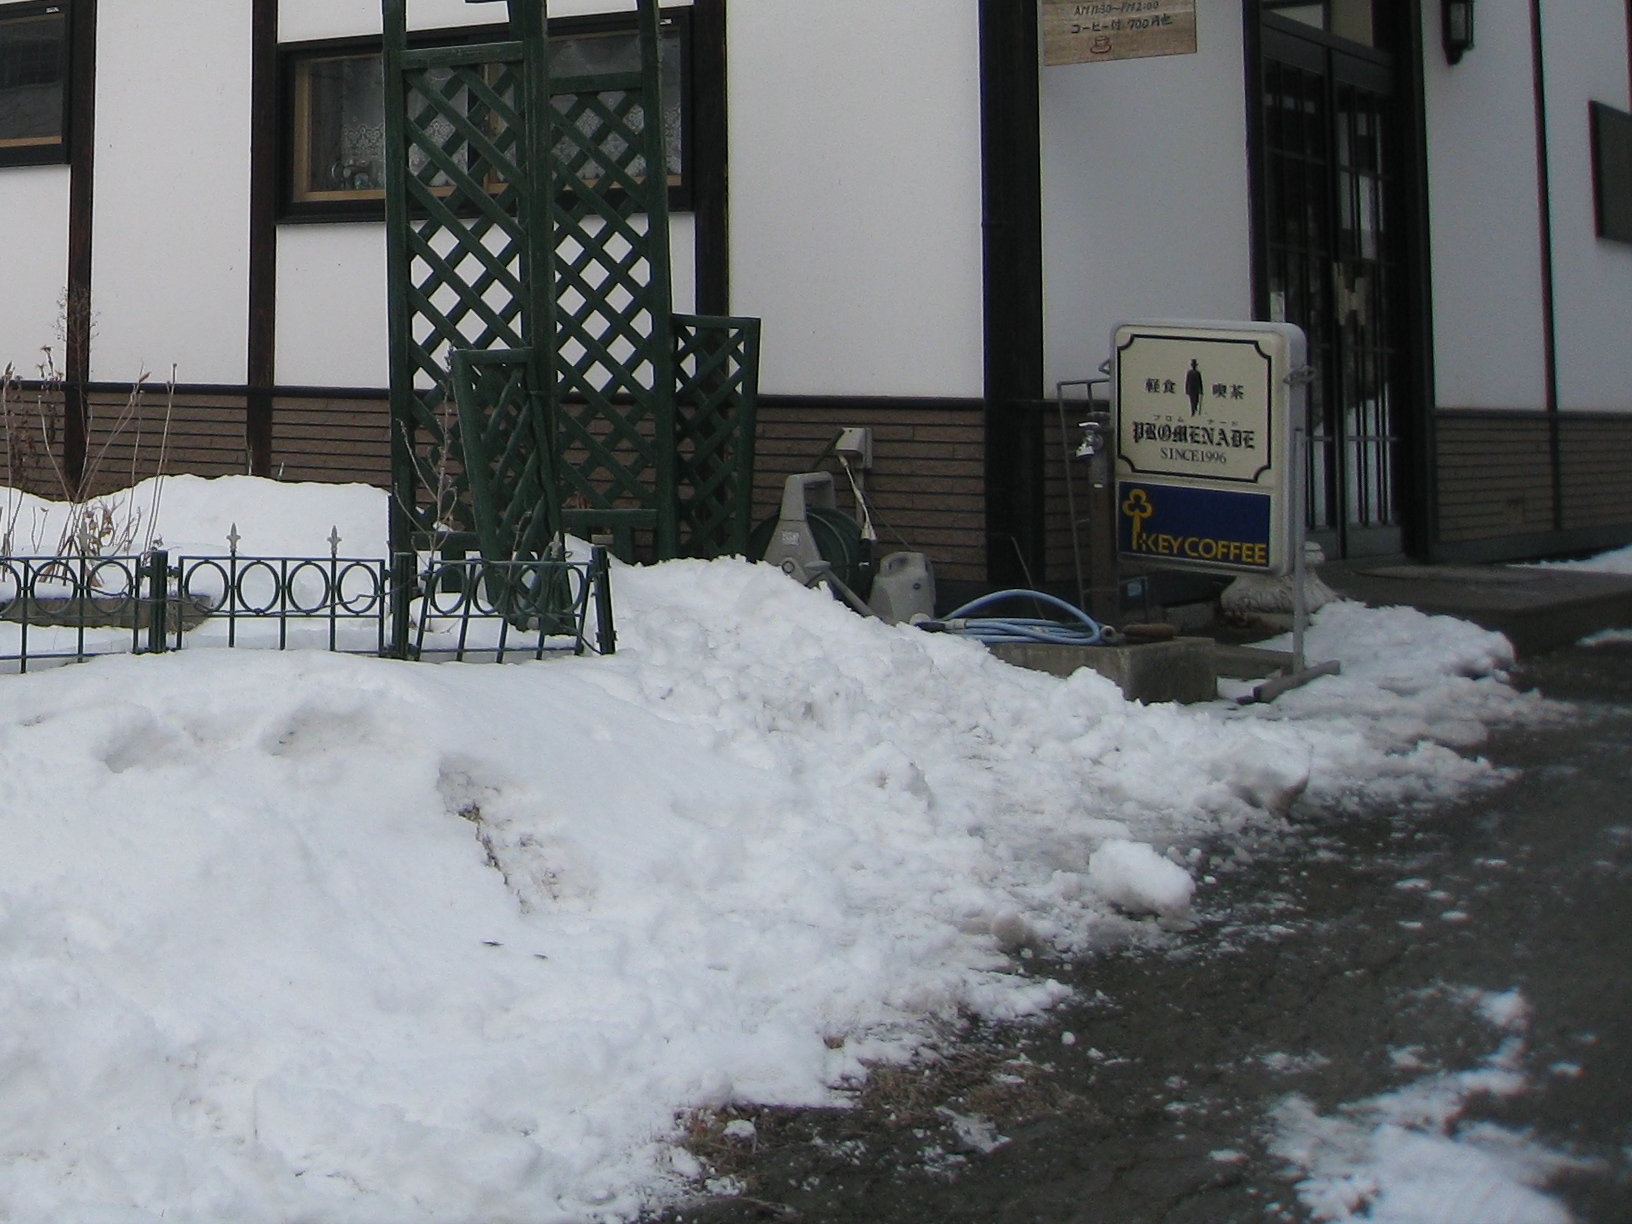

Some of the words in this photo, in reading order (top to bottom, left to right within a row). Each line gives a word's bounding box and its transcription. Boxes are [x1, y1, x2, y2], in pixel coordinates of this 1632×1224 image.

[1145, 378, 1176, 395] 軽食
[1212, 383, 1244, 400] 喫茶
[1132, 421, 1256, 450] PROMENADE
